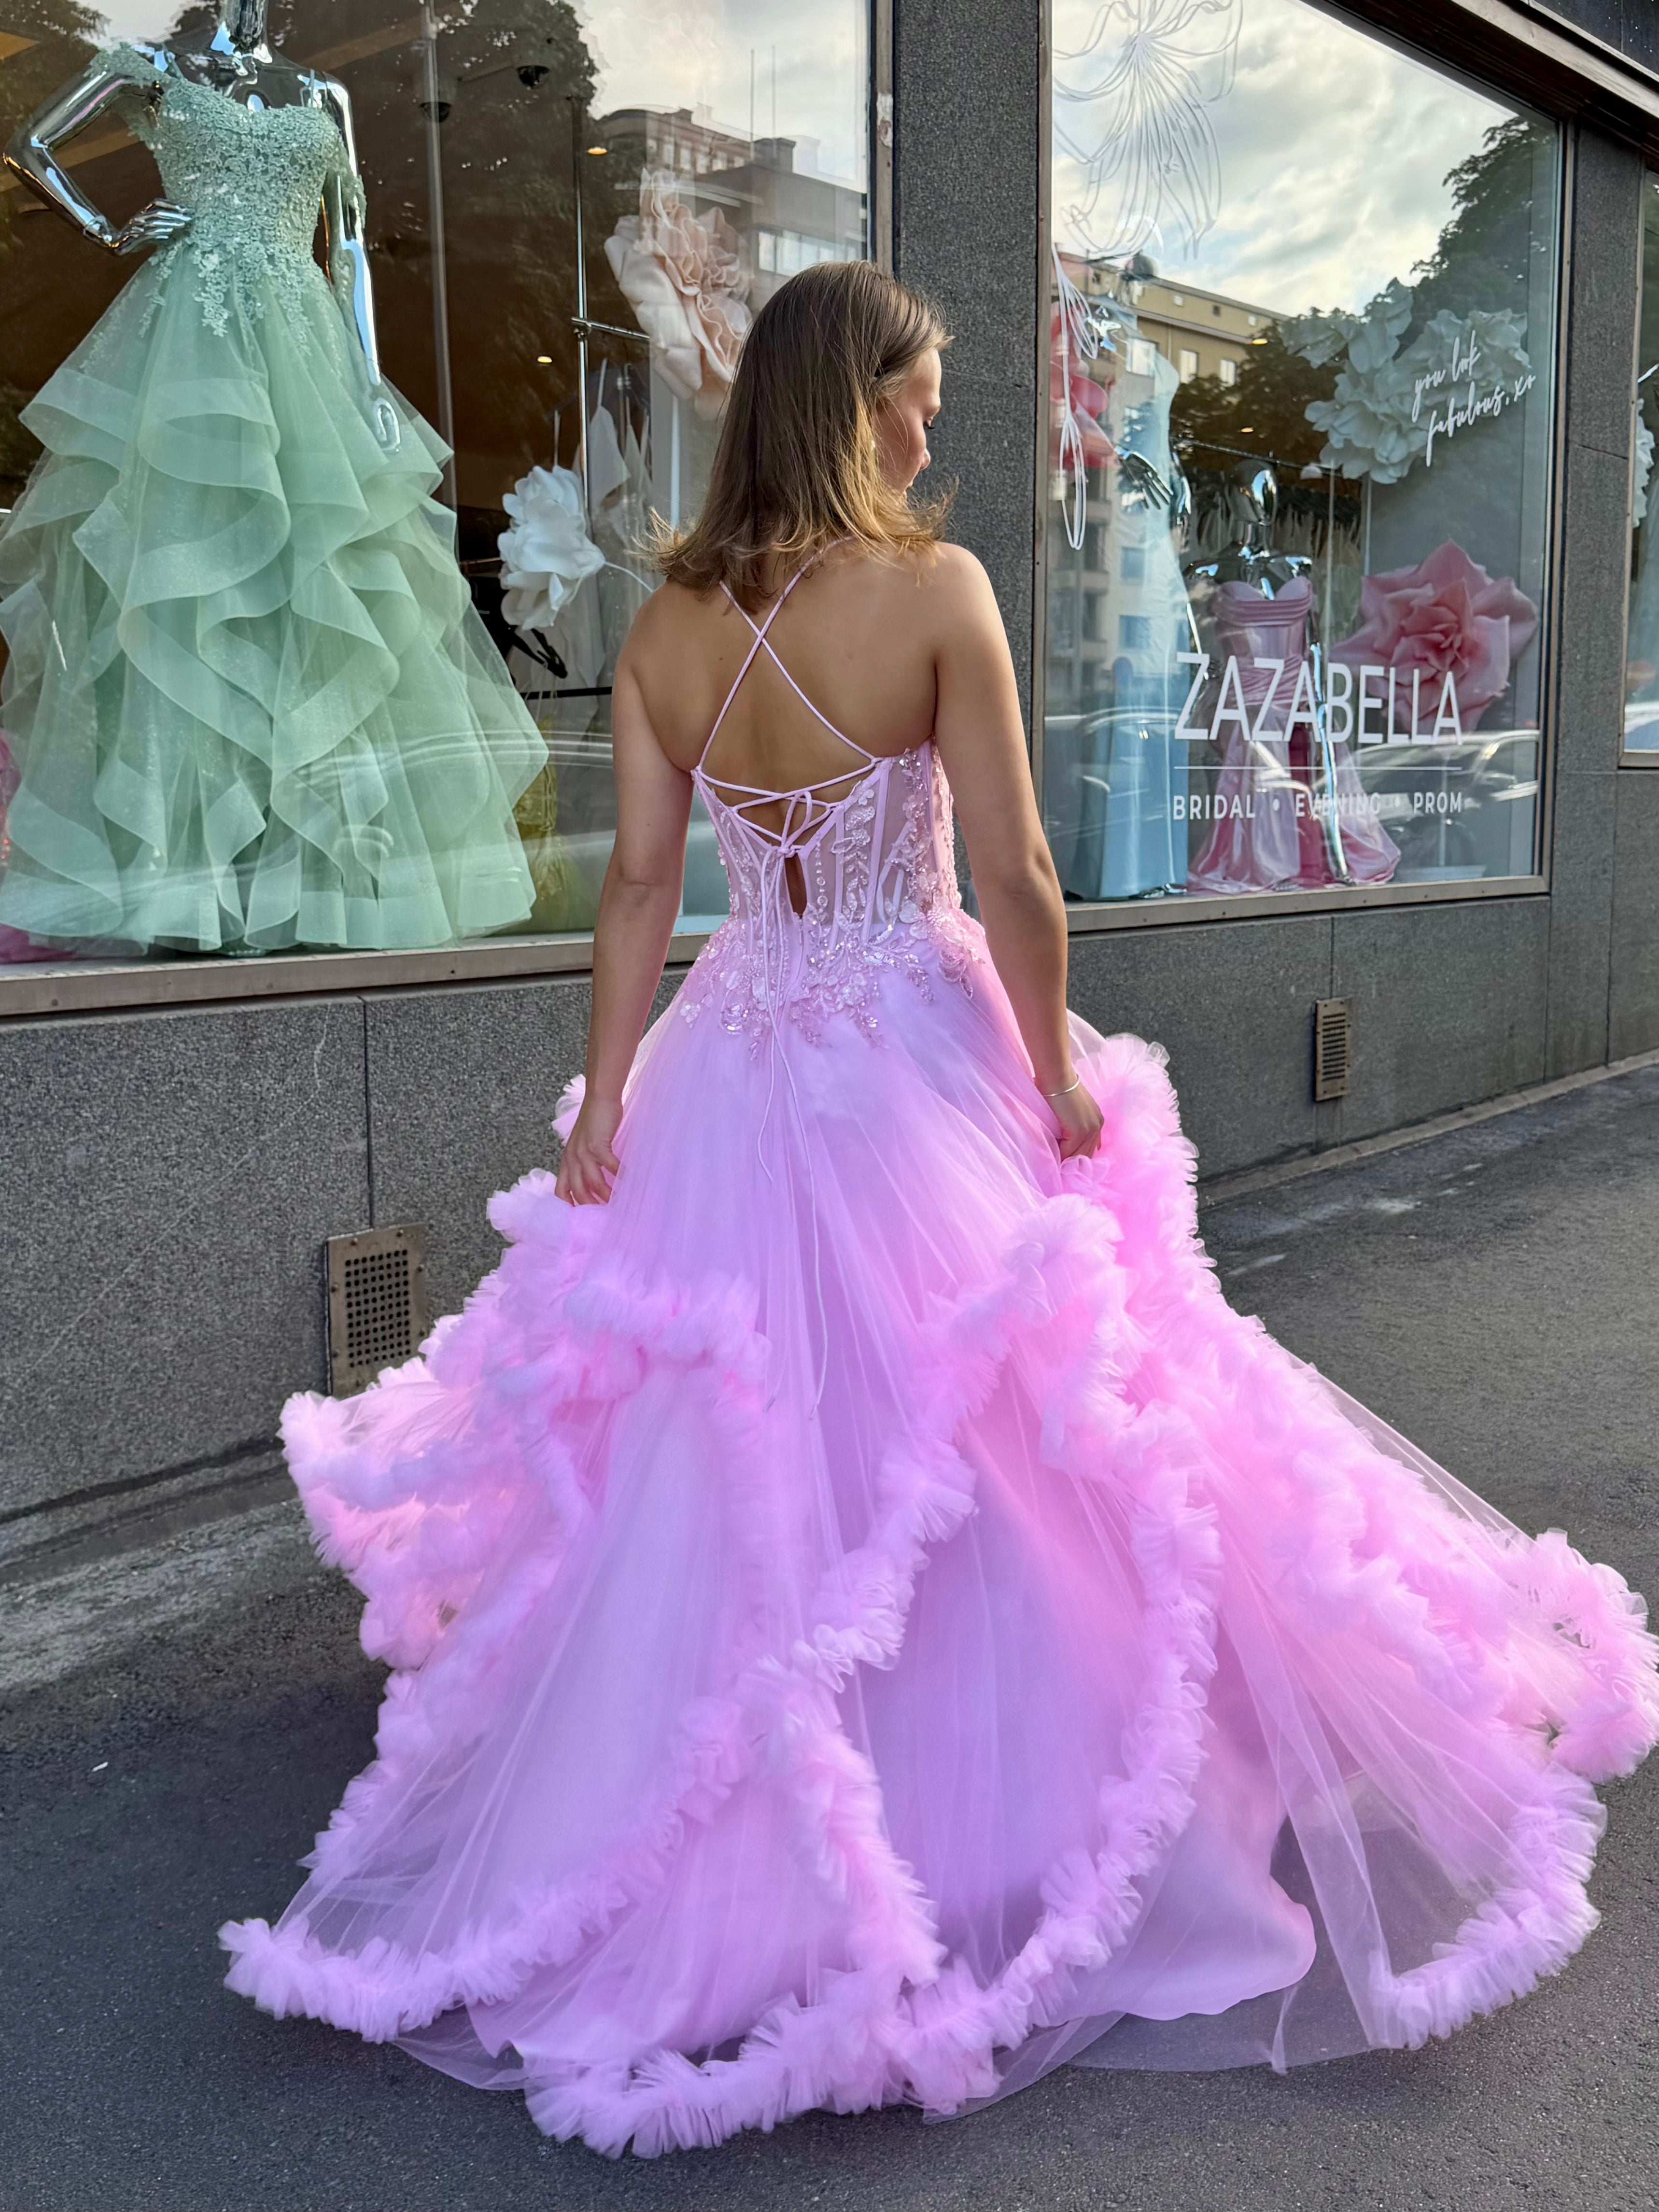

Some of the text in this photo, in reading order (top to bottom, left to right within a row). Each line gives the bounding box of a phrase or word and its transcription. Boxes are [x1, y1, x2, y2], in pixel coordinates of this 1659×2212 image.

[1412, 330, 1481, 423] you look
[1513, 375, 1536, 402] xo
[1174, 651, 1462, 746] ZAZABELLA
[1173, 791, 1462, 820] BRIDAL EVENING PROM
